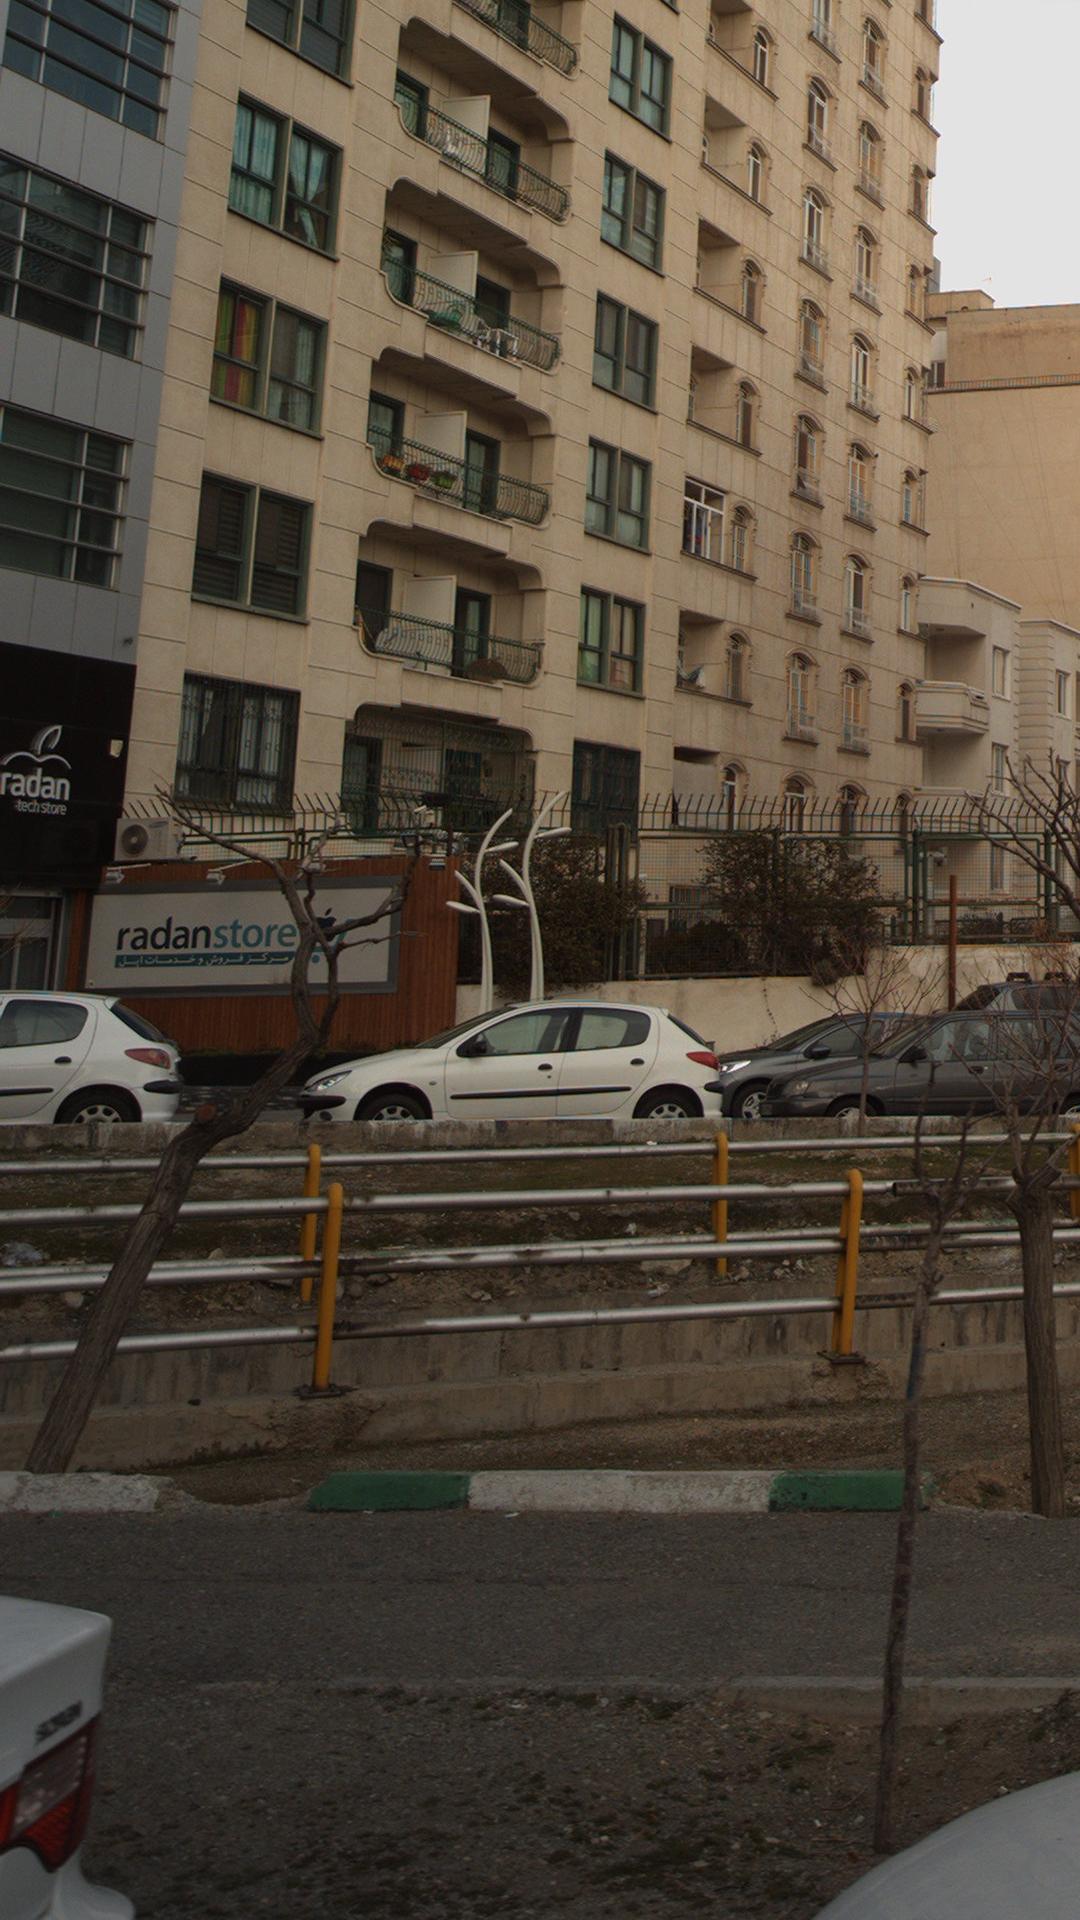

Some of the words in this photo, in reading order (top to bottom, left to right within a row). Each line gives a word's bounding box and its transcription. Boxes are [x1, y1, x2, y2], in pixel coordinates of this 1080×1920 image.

[0, 767, 71, 801] radan
[17, 800, 40, 813] tech
[41, 802, 67, 816] store
[116, 916, 296, 951] radanstore
